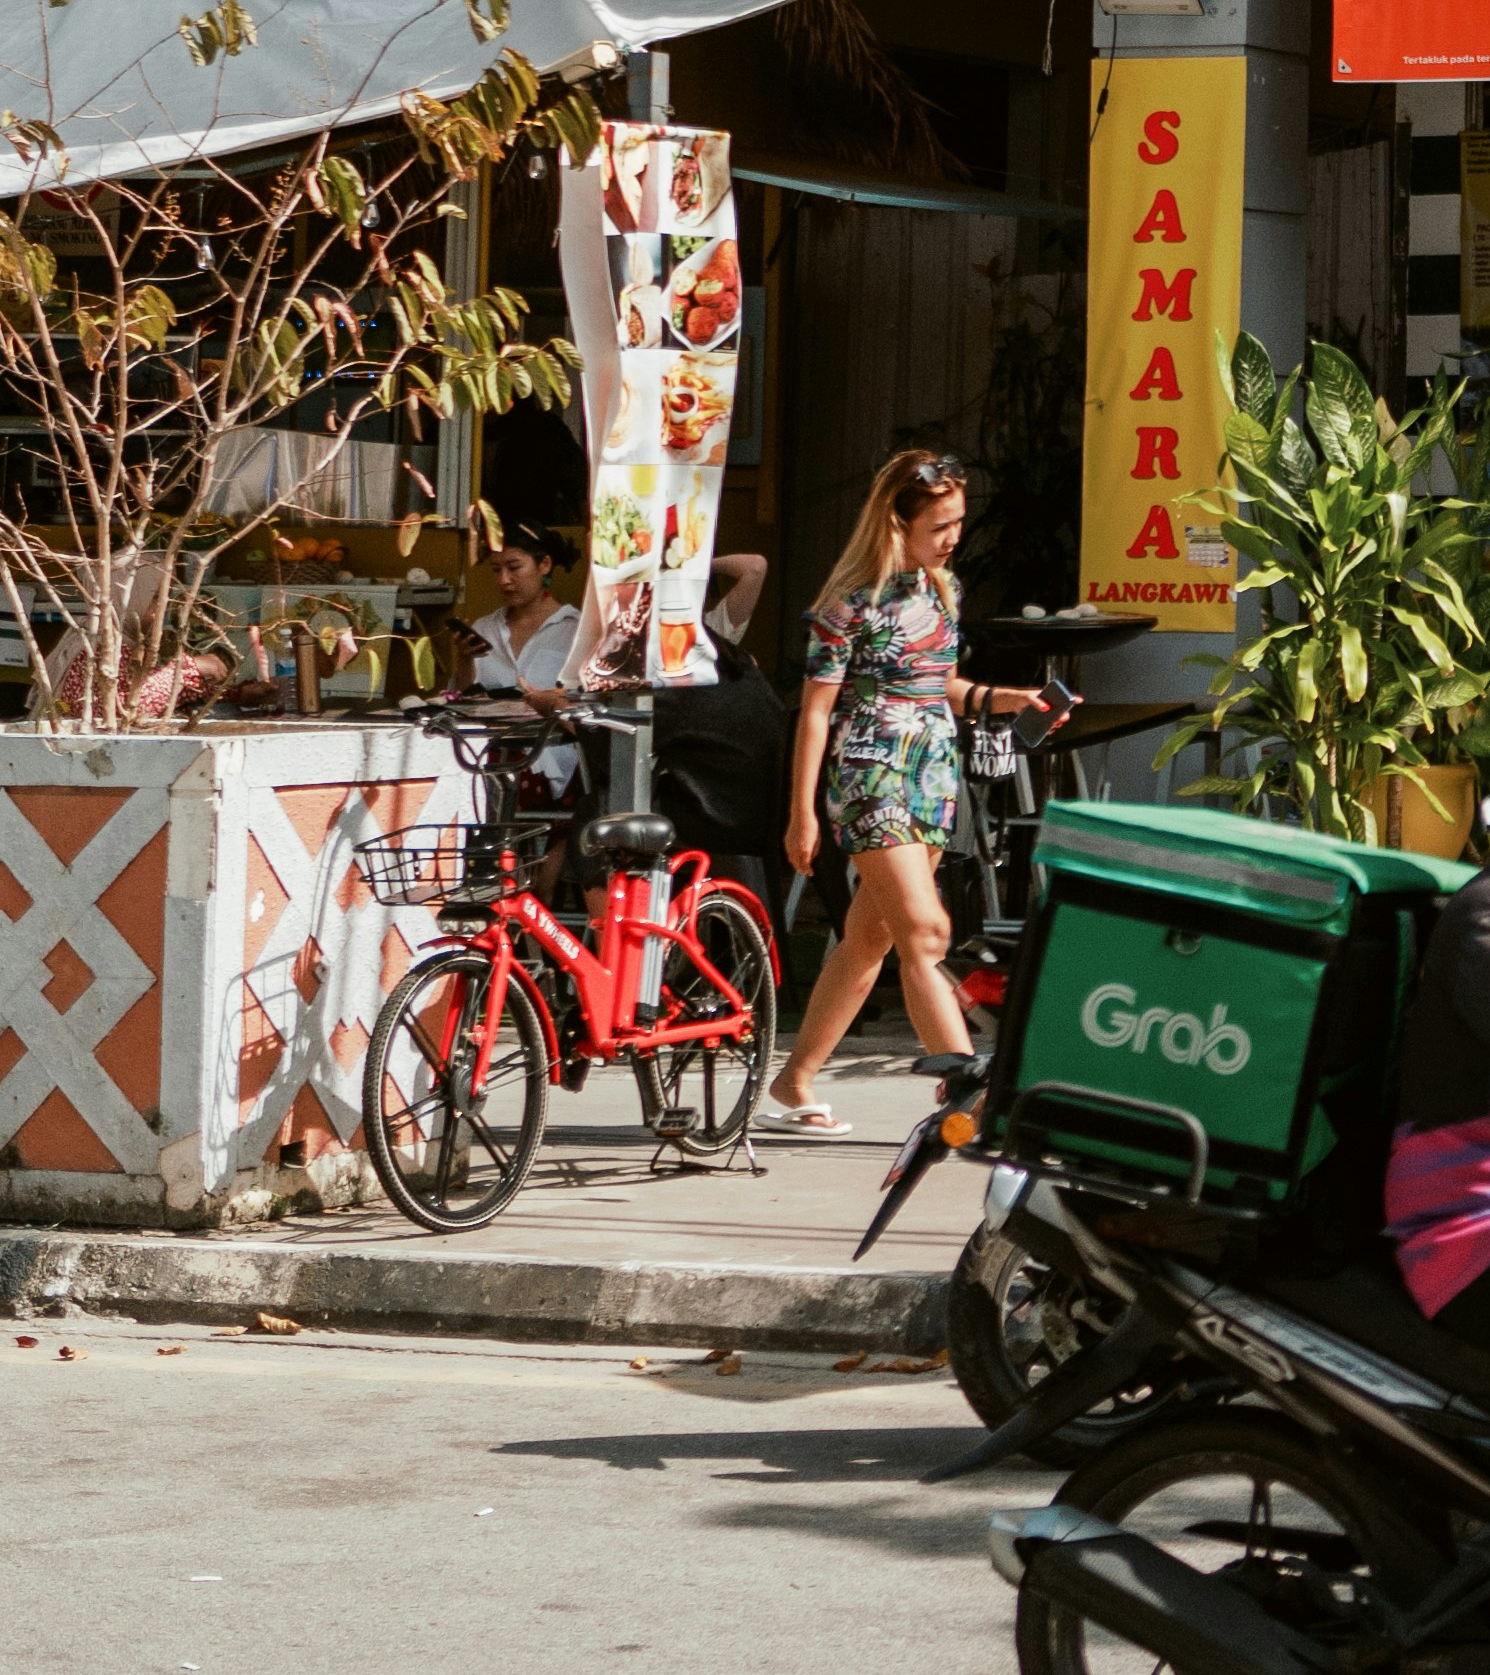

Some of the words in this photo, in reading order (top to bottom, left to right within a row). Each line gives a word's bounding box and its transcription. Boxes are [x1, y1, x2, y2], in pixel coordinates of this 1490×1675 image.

[1403, 55, 1449, 65] Tertakluk
[1450, 56, 1475, 66] pada
[1126, 111, 1198, 560] SAMARA
[1088, 582, 1230, 604] LANGKAWI
[1080, 981, 1253, 1077] Grab
